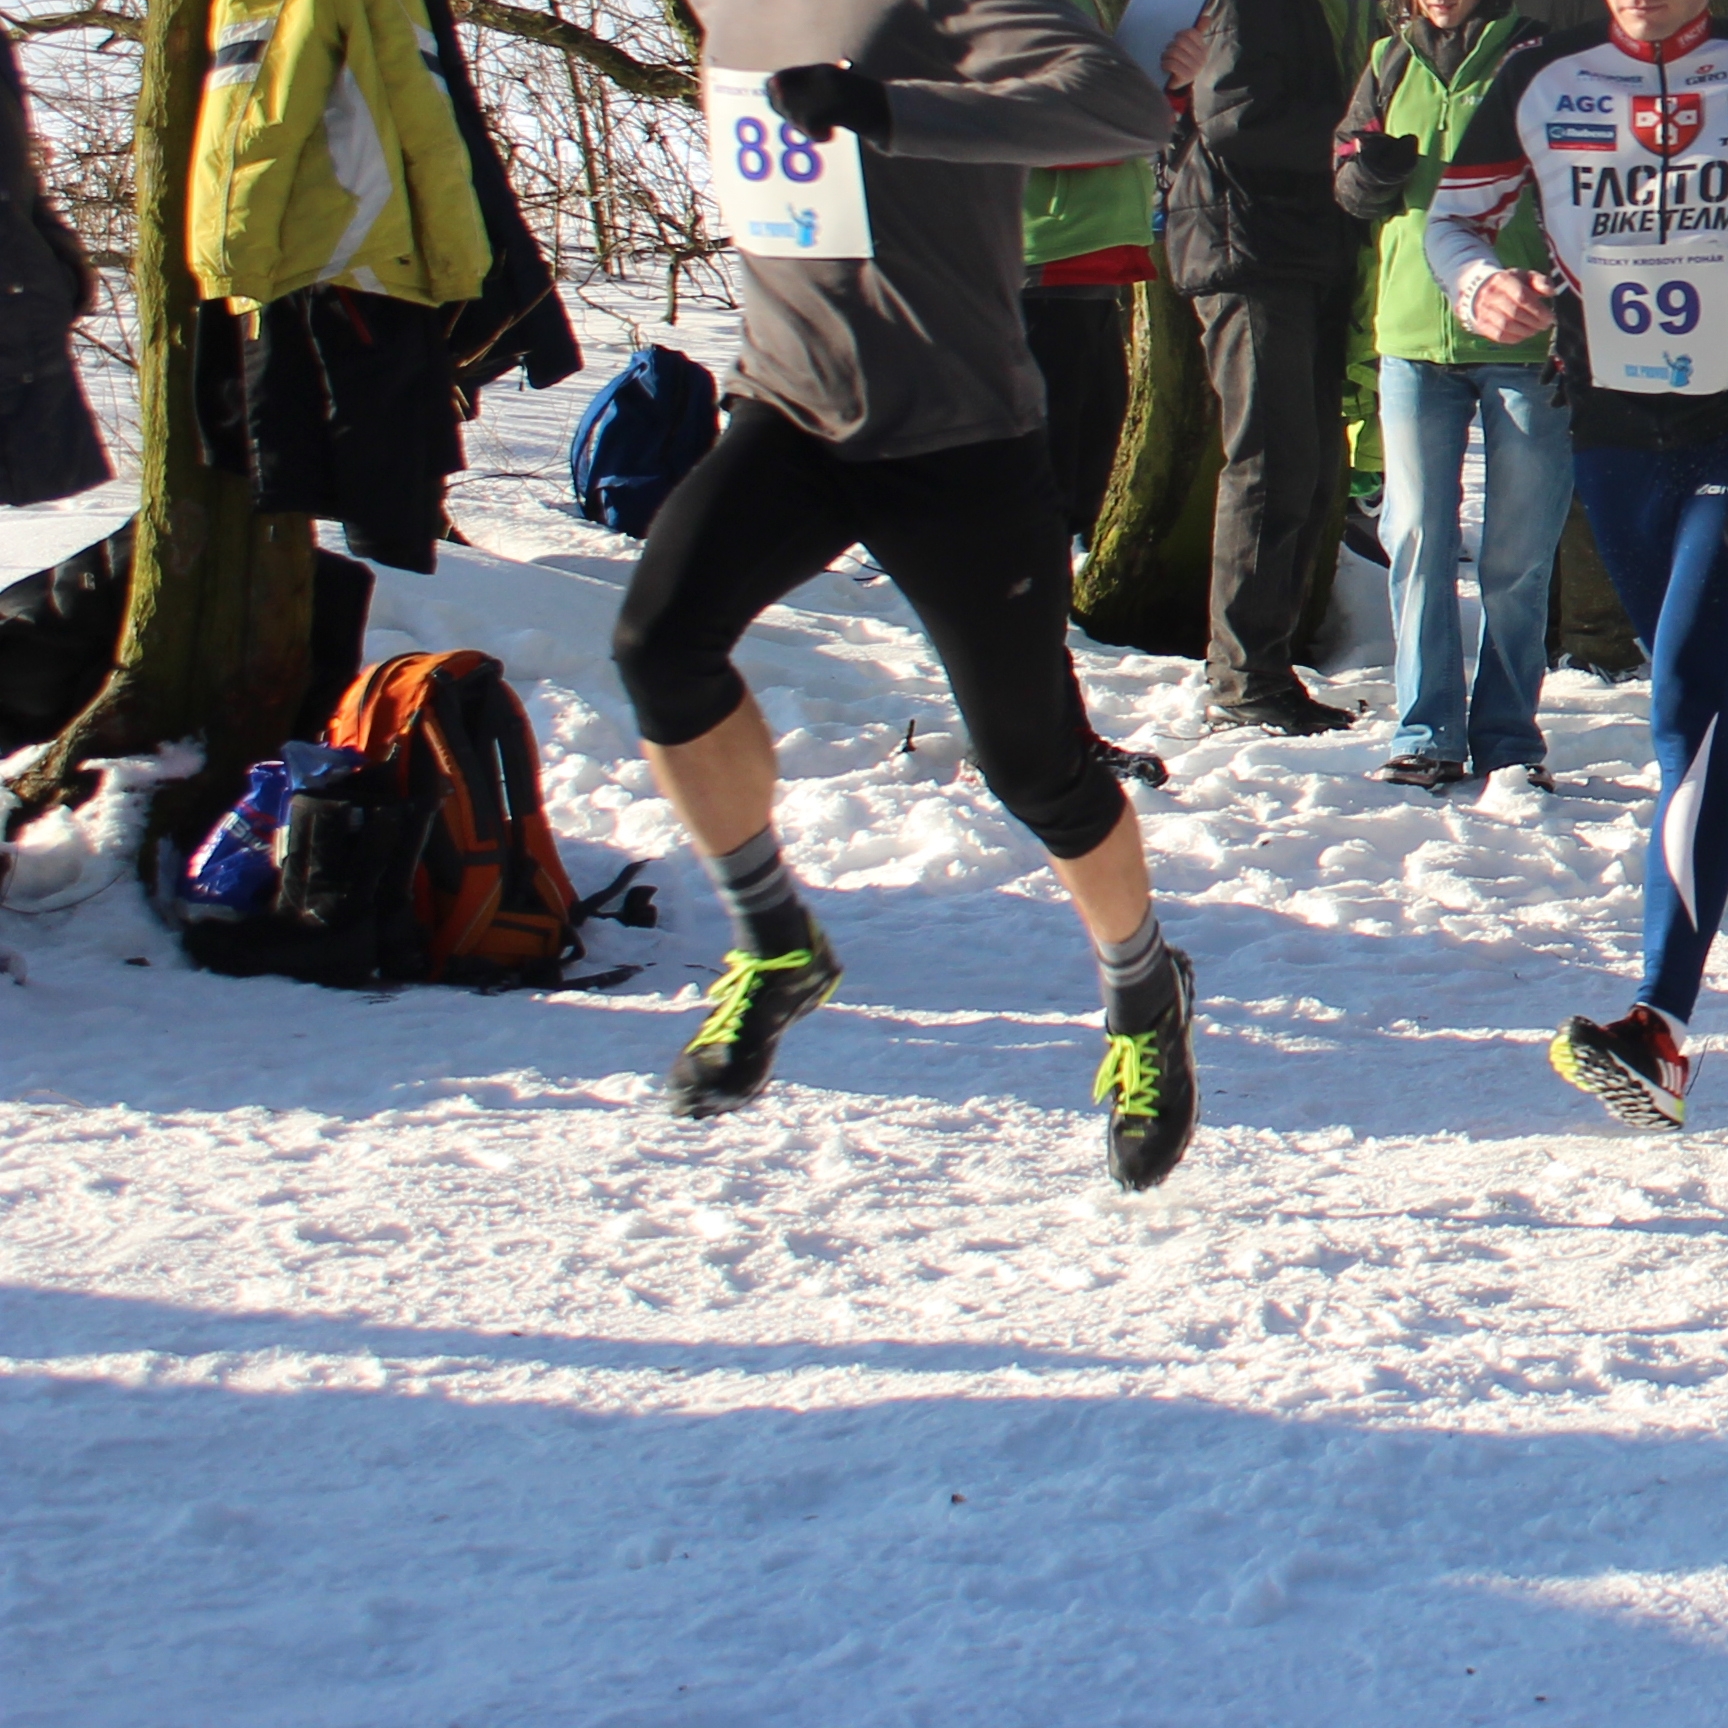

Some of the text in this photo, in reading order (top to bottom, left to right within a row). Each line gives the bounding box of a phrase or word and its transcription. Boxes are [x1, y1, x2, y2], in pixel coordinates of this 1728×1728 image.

[1556, 95, 1614, 114] AGC
[736, 116, 824, 183] 88
[1591, 210, 1655, 237] BIKE
[1610, 280, 1701, 335] 69
